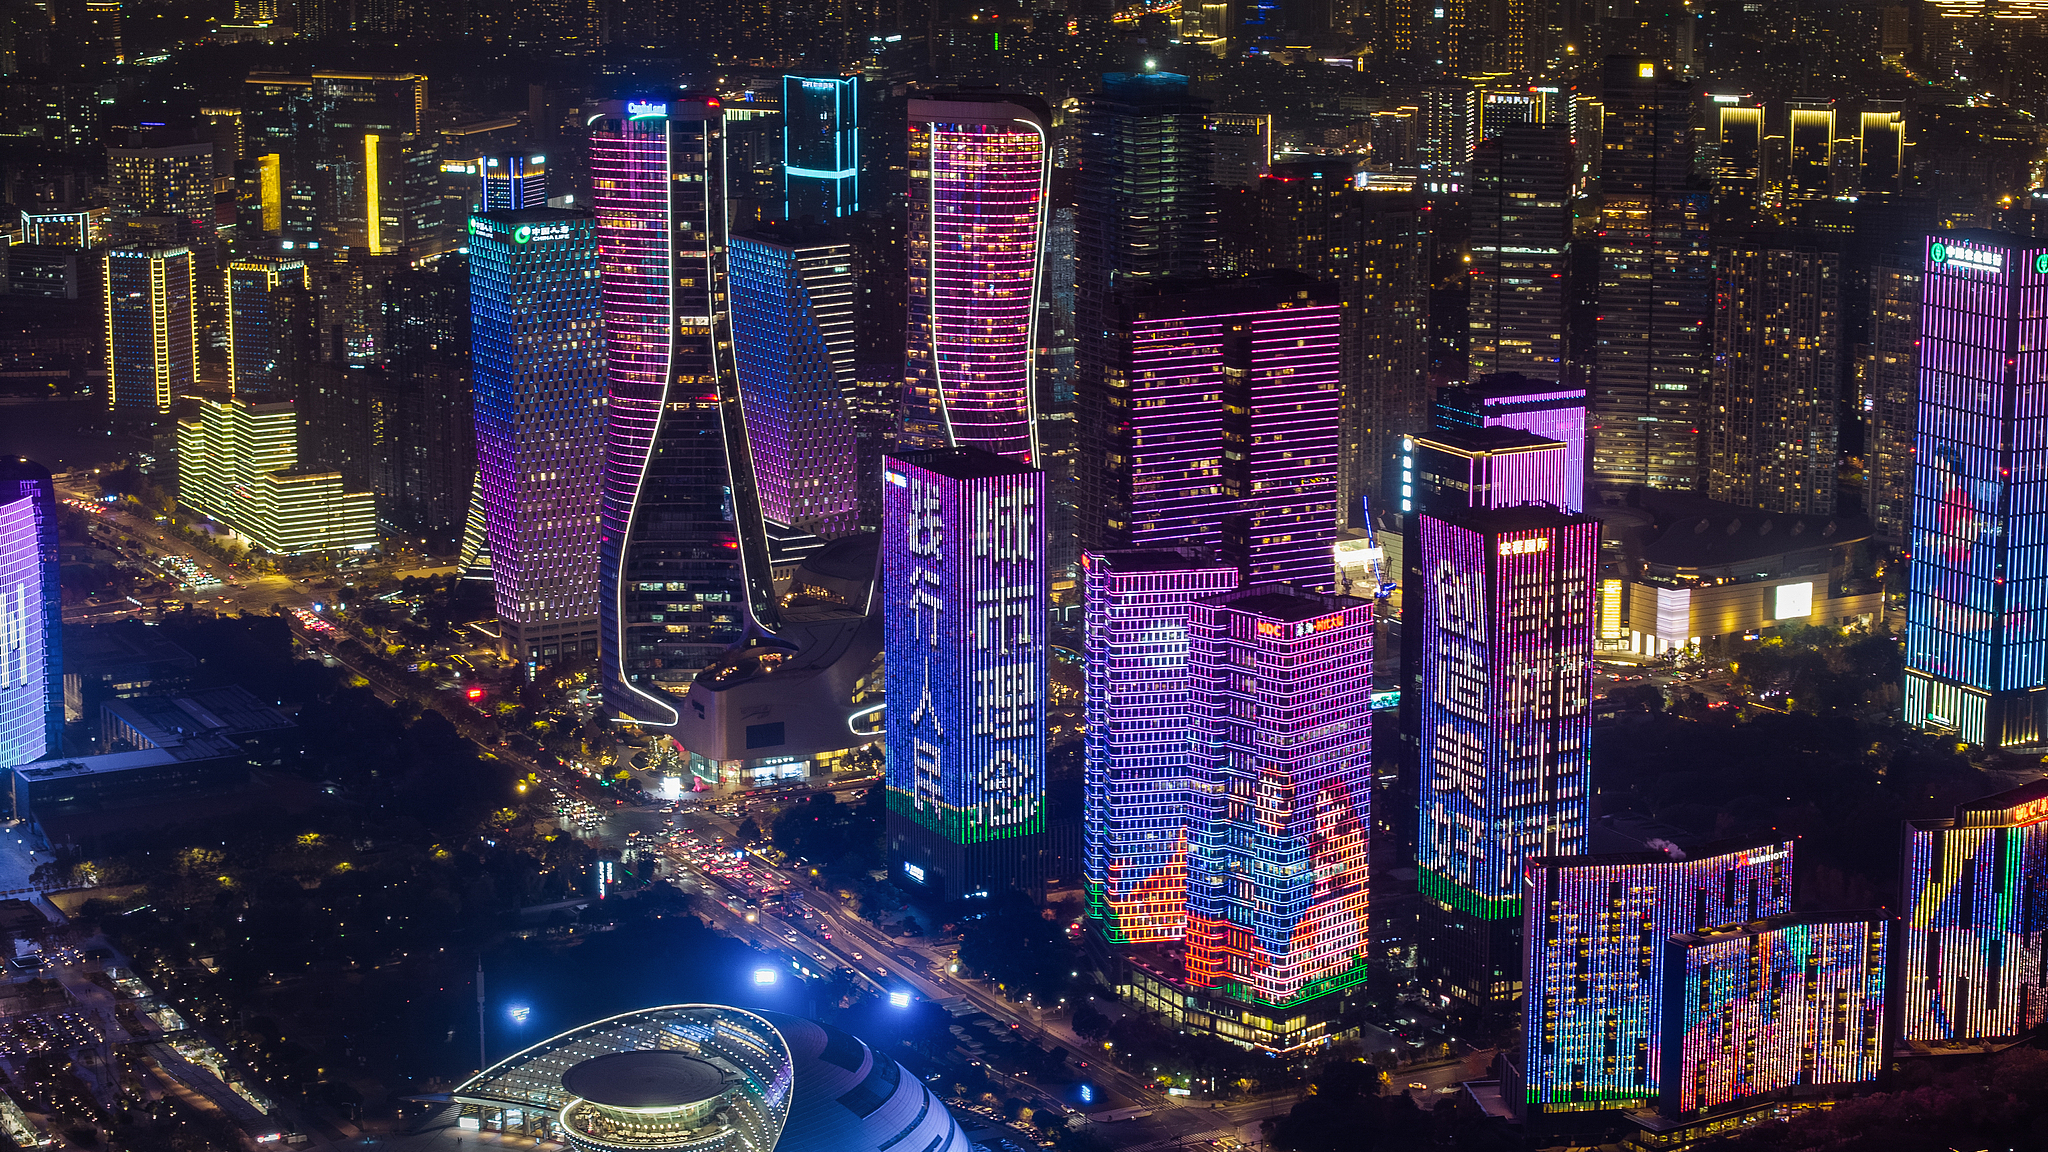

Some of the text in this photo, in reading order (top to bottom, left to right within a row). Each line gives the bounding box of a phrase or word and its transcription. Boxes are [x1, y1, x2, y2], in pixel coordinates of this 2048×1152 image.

[1500, 537, 1549, 555] 宏程国际
[1749, 850, 1789, 866] MARRIOTT
